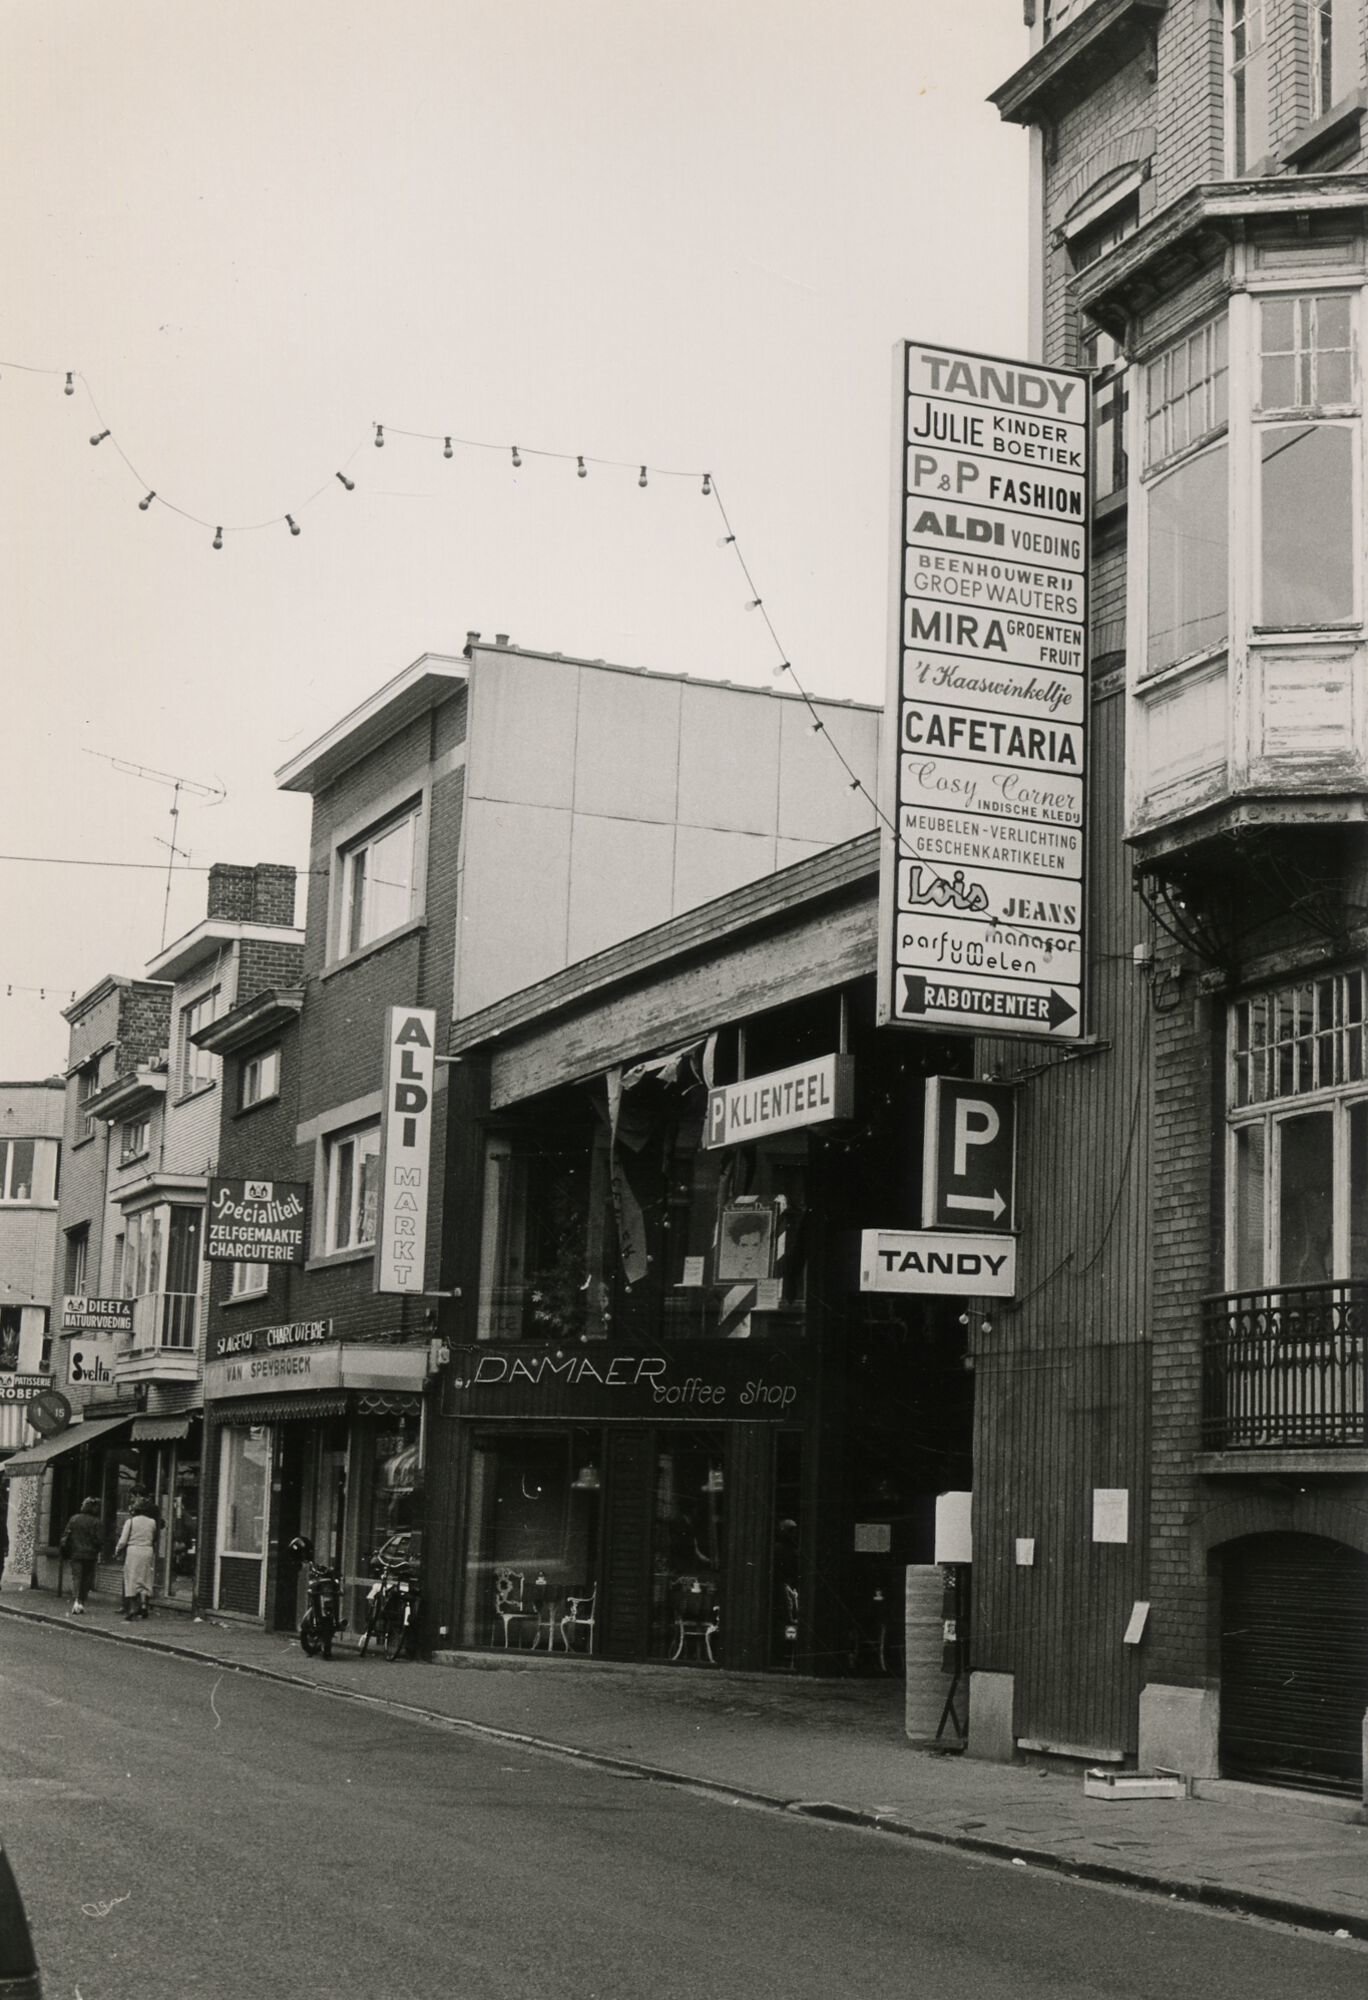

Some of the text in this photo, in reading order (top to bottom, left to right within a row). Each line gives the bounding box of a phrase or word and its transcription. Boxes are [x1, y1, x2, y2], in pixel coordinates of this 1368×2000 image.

[921, 355, 1076, 414] TANDY
[914, 402, 984, 447] JULIE
[993, 416, 1067, 443] KINDER
[993, 437, 1081, 467] BOETIEK
[989, 476, 1081, 515] FASHION
[913, 510, 1080, 560] ALDI VOEDING
[919, 554, 1073, 592] BEENHOUWERIJ
[914, 572, 1078, 615] GROEP WAUTERS
[911, 608, 1008, 652] MIRA
[1007, 619, 1082, 646] GROENTEN
[1040, 646, 1081, 667] FRUIT
[932, 664, 1072, 712] Kaaswinkeltje
[905, 711, 1077, 766] CAFETARIA
[908, 761, 1076, 810] Cosy Corner
[978, 799, 1038, 818] INDISCHE
[917, 837, 1065, 869] GESCHENKARTIKELEN
[908, 865, 990, 912] Lois
[1002, 897, 1077, 925] JEANS
[902, 931, 984, 962] parfum
[924, 985, 1050, 1019] RABOTCENTER
[395, 1017, 432, 1148] ALDI
[711, 1072, 830, 1141] P KLIENTEEL
[954, 1098, 1000, 1176] P
[212, 1188, 304, 1224] Spécialiteit
[209, 1225, 302, 1244] ZELFGEMAAKTE
[393, 1167, 421, 1285] MARKT
[209, 1242, 294, 1260] CHARCUTERIE
[878, 1250, 1008, 1276] TANDY
[65, 1314, 131, 1329] NATUURVOEDING
[89, 1300, 122, 1314] DIEET
[227, 1356, 311, 1382] VAN SPEYBROECK
[740, 1378, 797, 1409] Shop
